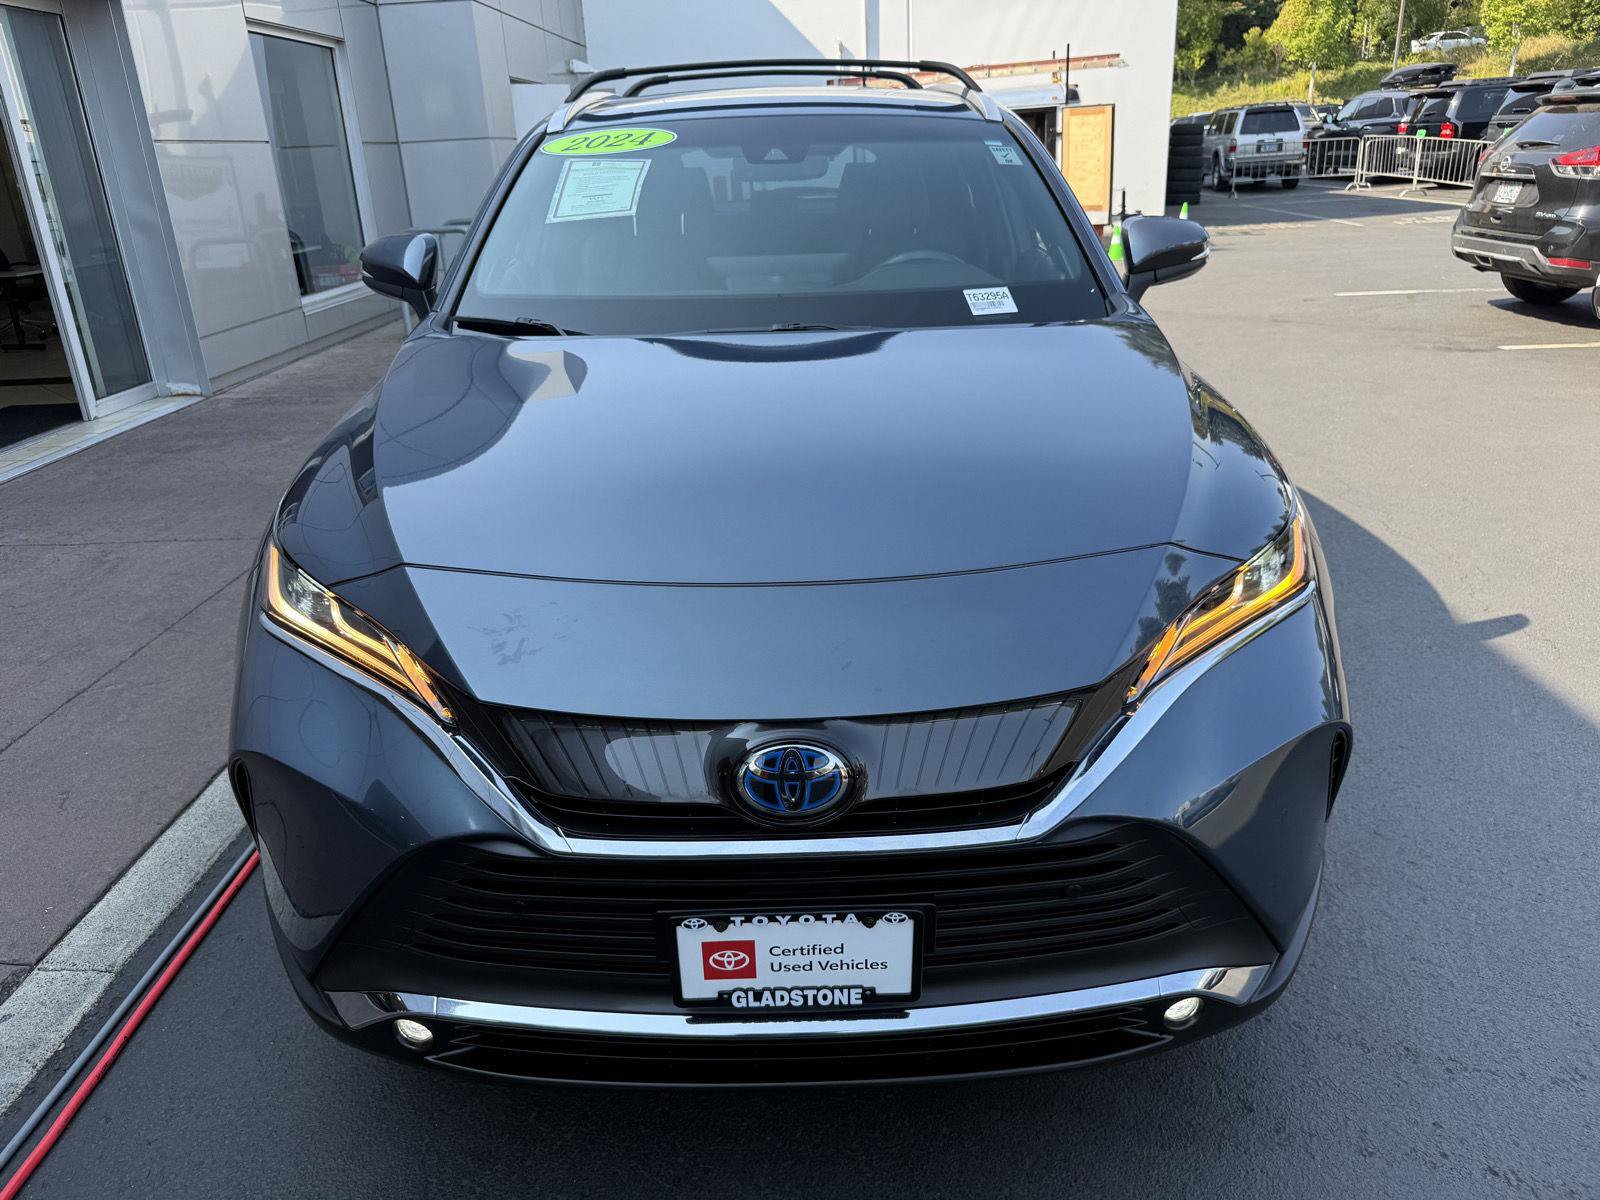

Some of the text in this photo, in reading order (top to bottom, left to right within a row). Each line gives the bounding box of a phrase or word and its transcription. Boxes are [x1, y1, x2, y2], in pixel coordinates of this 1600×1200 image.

[561, 131, 656, 152] 2024
[965, 291, 1010, 302] T63295A
[730, 913, 861, 927] TOYOTA
[769, 943, 845, 957] Certified
[769, 958, 888, 972] Used Vehicles
[731, 987, 863, 1008] GLADSTONE
